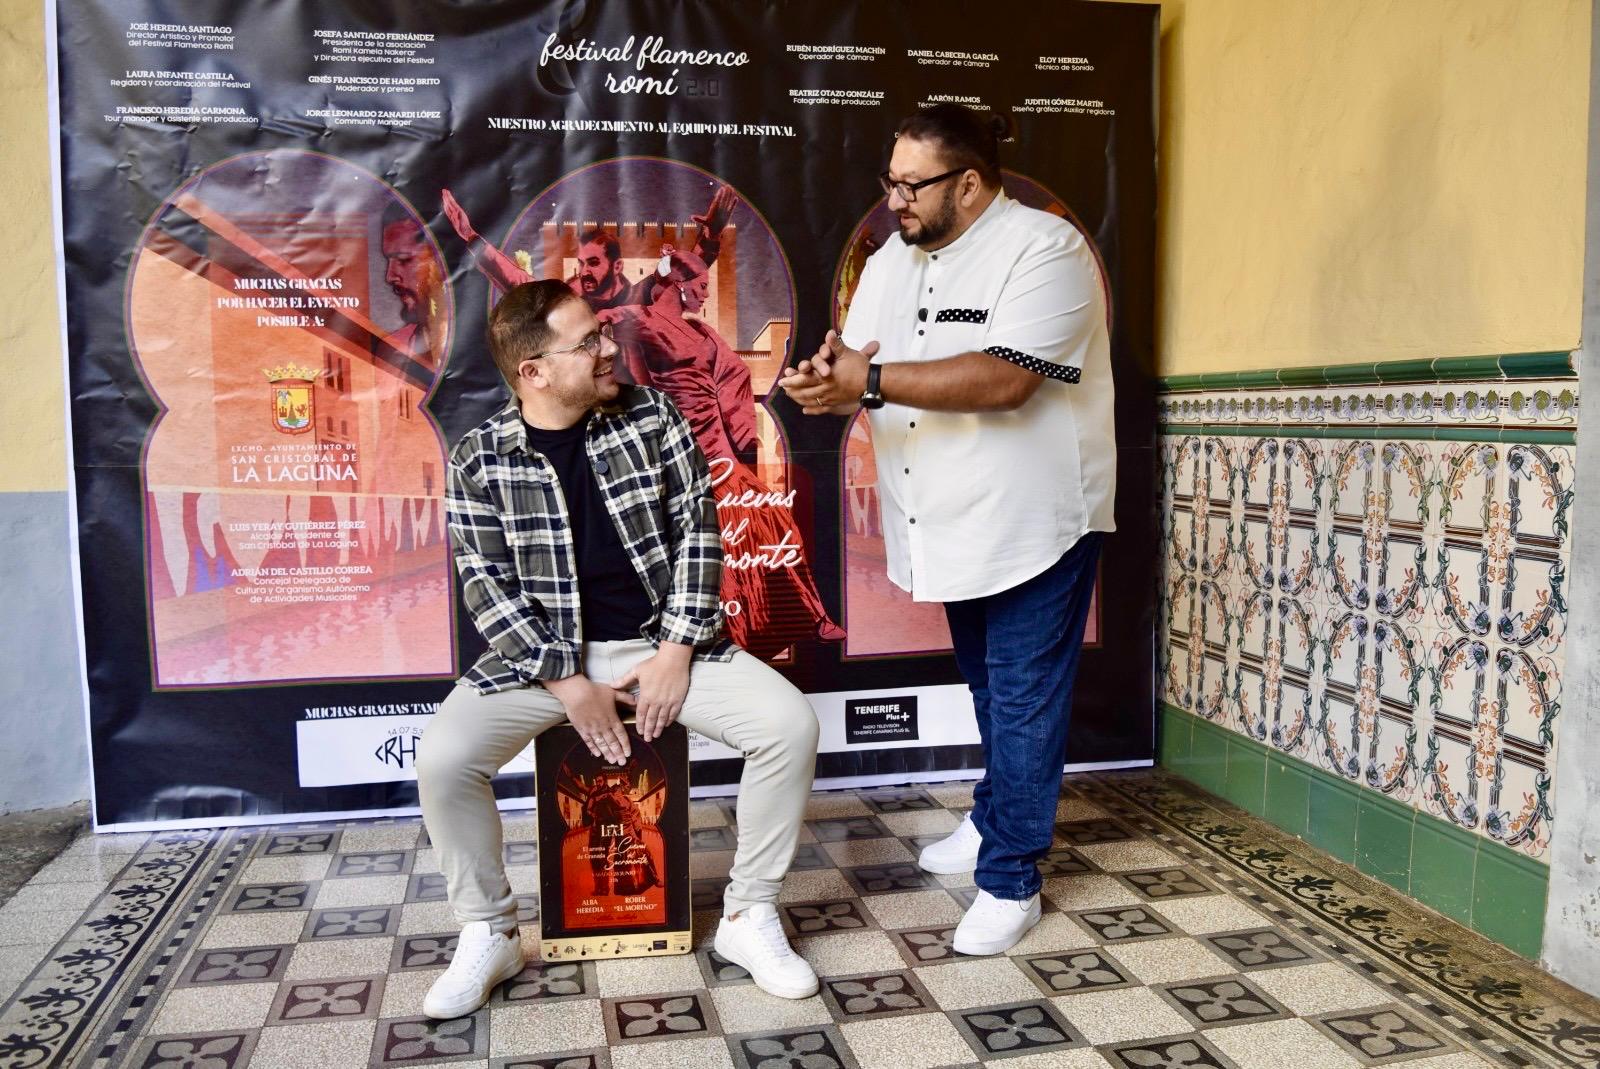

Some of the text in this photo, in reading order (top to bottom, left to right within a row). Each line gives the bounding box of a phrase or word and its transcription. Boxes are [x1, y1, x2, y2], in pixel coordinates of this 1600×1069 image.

[130, 22, 232, 33] JOSÉ HEREDIA SANTIAGO
[387, 33, 434, 41] FERNÁNDEZ
[540, 32, 749, 70] festival flamenco
[787, 44, 811, 52] RUBÉN
[813, 45, 854, 53] RODRÍGUEZ
[935, 51, 971, 59] CABECERA
[309, 75, 332, 83] GINÉS
[605, 69, 679, 96] romí
[846, 90, 884, 98] GONZÁLEZ
[417, 110, 440, 118] LÓPEZ
[488, 117, 796, 136] NUESTRO AGRADECIMIENTO AL EQUIPO DEL FESTIVAL
[235, 279, 342, 289] MUCHAS GRACIAS
[218, 297, 359, 309] POR HACER EL EVENTO
[258, 316, 324, 327] POSIBLE A:
[232, 456, 256, 464] SAN
[234, 464, 358, 482] LA LAGUNA
[230, 523, 250, 531] LUIS
[252, 523, 284, 531] YERAY
[290, 567, 333, 575] CASTILLO
[335, 566, 372, 574] CORREA
[305, 706, 356, 719] MUCHAS
[359, 704, 409, 715] GRACIAS
[854, 704, 899, 714] TENERIFE
